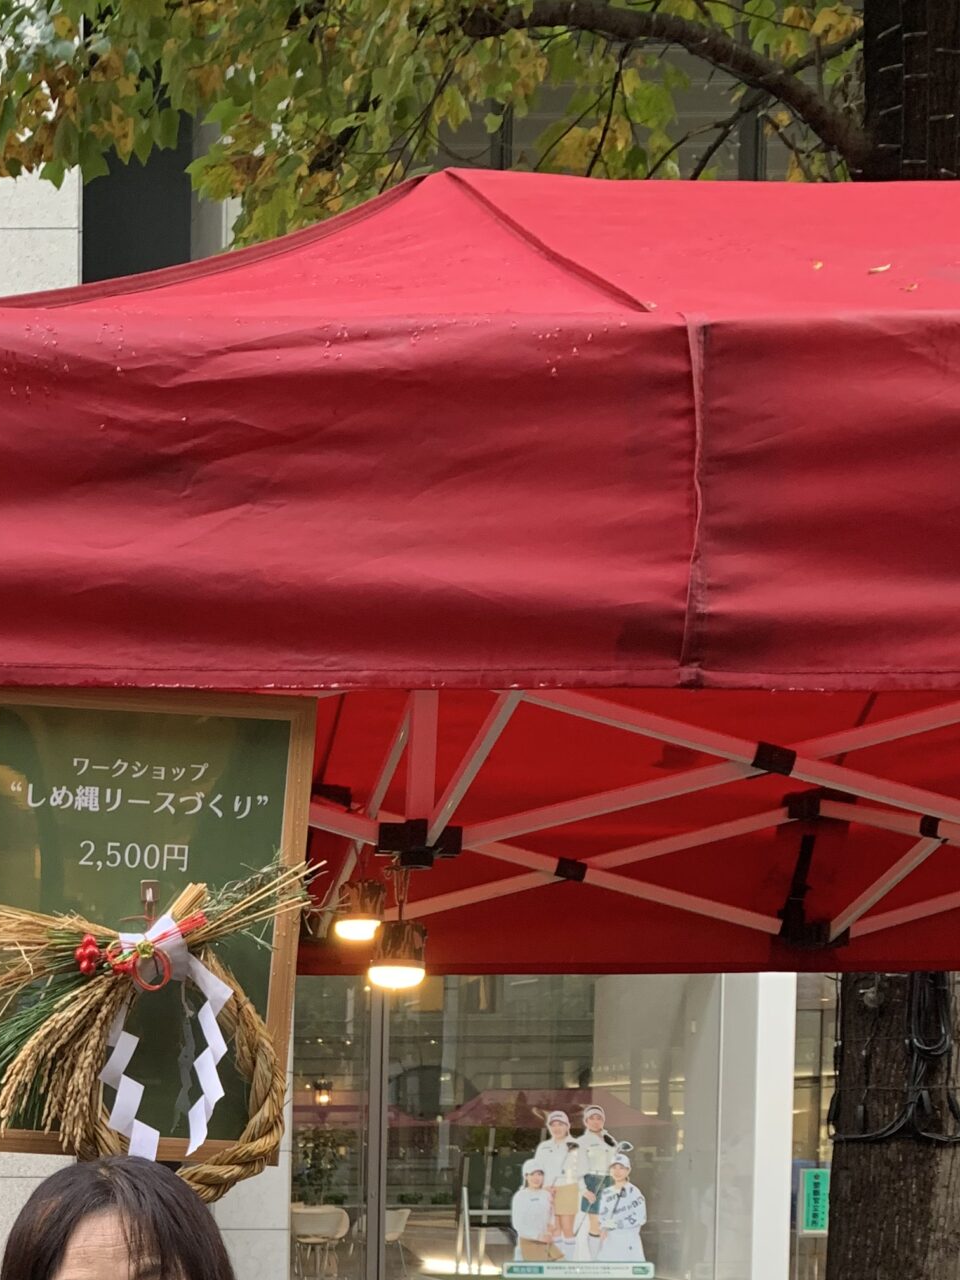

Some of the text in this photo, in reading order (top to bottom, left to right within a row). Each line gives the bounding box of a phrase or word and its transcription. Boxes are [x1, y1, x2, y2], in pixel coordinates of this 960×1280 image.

[73, 757, 209, 782] ワークショップ
[78, 840, 189, 872] 2,500円
